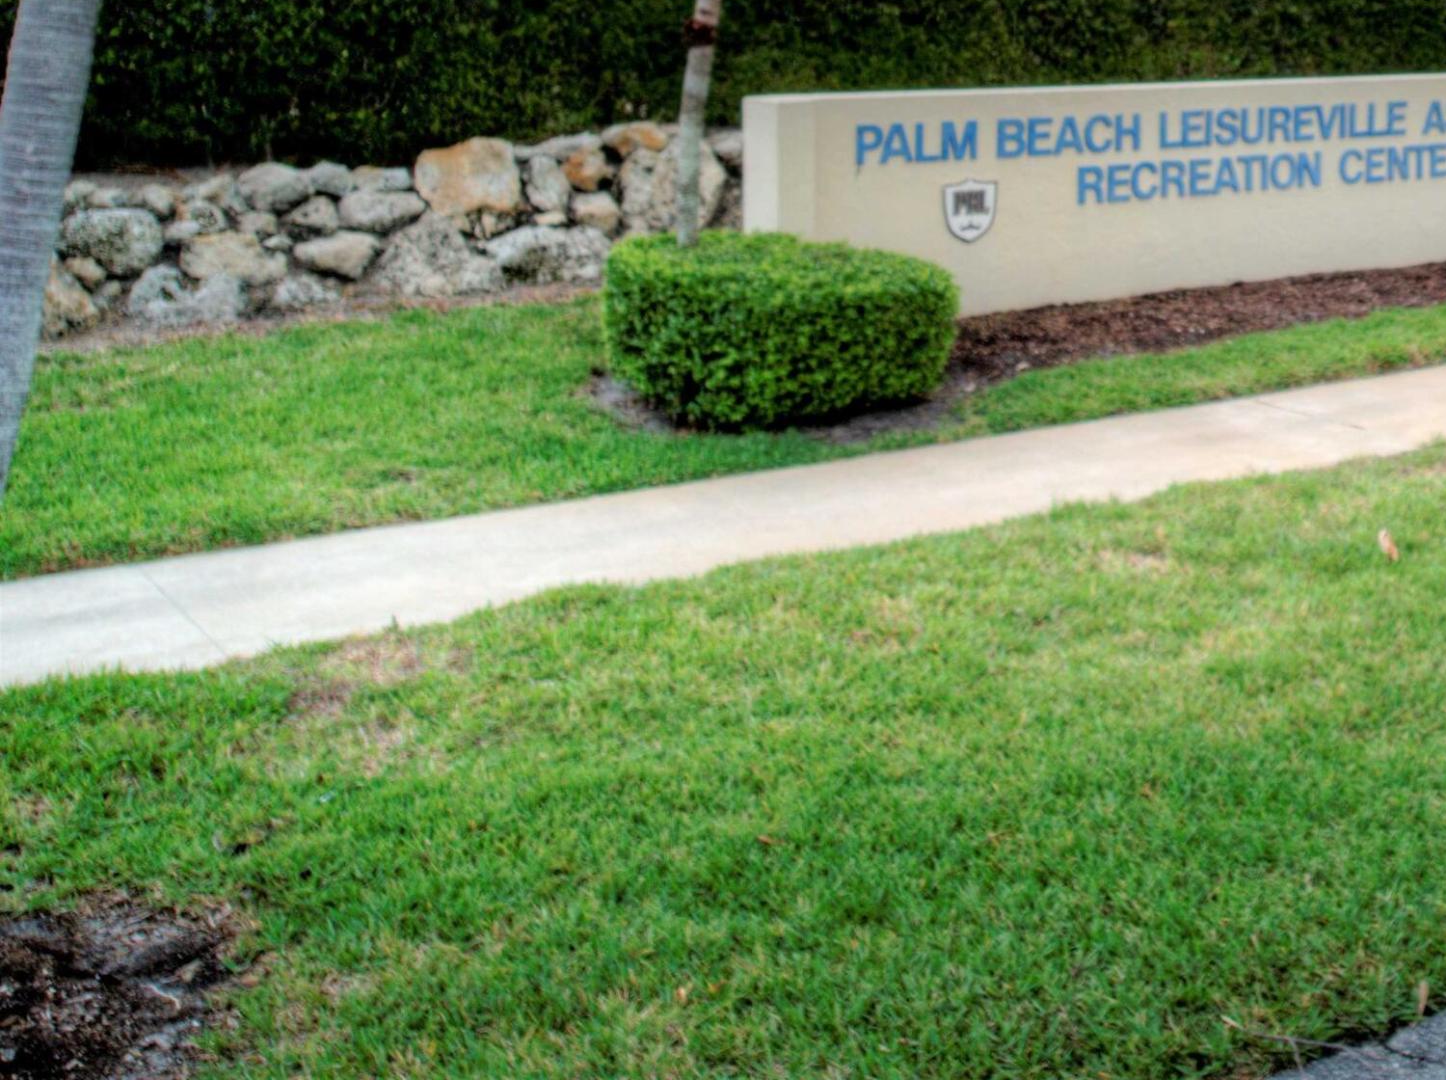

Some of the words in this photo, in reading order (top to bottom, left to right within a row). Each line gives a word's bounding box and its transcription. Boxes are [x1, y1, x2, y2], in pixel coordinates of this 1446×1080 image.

[855, 120, 978, 166] PALM
[995, 113, 1141, 159] BEACH
[1158, 100, 1407, 149] LEISUREVILLE
[1077, 151, 1322, 205] RECREATION
